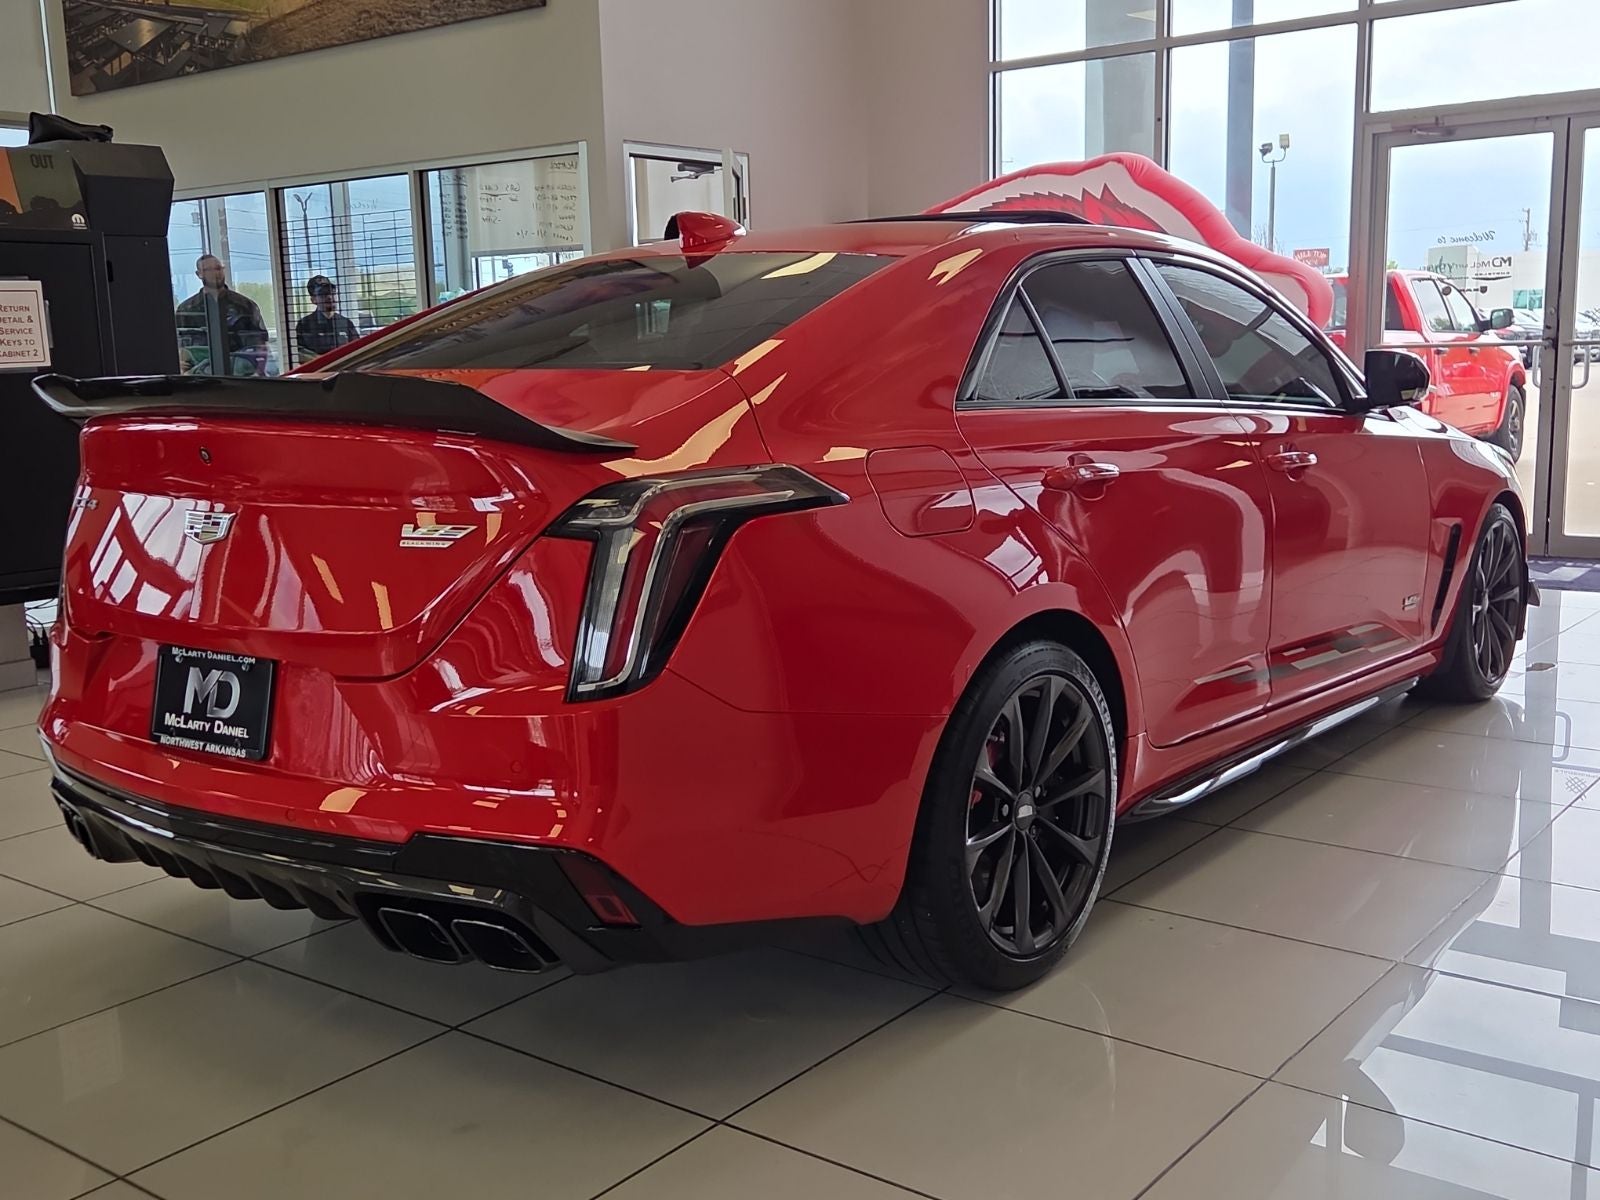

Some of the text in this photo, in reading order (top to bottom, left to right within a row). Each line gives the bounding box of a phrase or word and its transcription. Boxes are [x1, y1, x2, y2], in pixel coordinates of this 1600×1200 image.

[30, 153, 54, 169] OUT
[0, 327, 33, 335] SERVICE
[33, 349, 39, 357] 2
[183, 666, 240, 719] MD
[214, 720, 249, 739] DANIEL
[160, 735, 246, 758] NORTHWEST ARKANSAS
